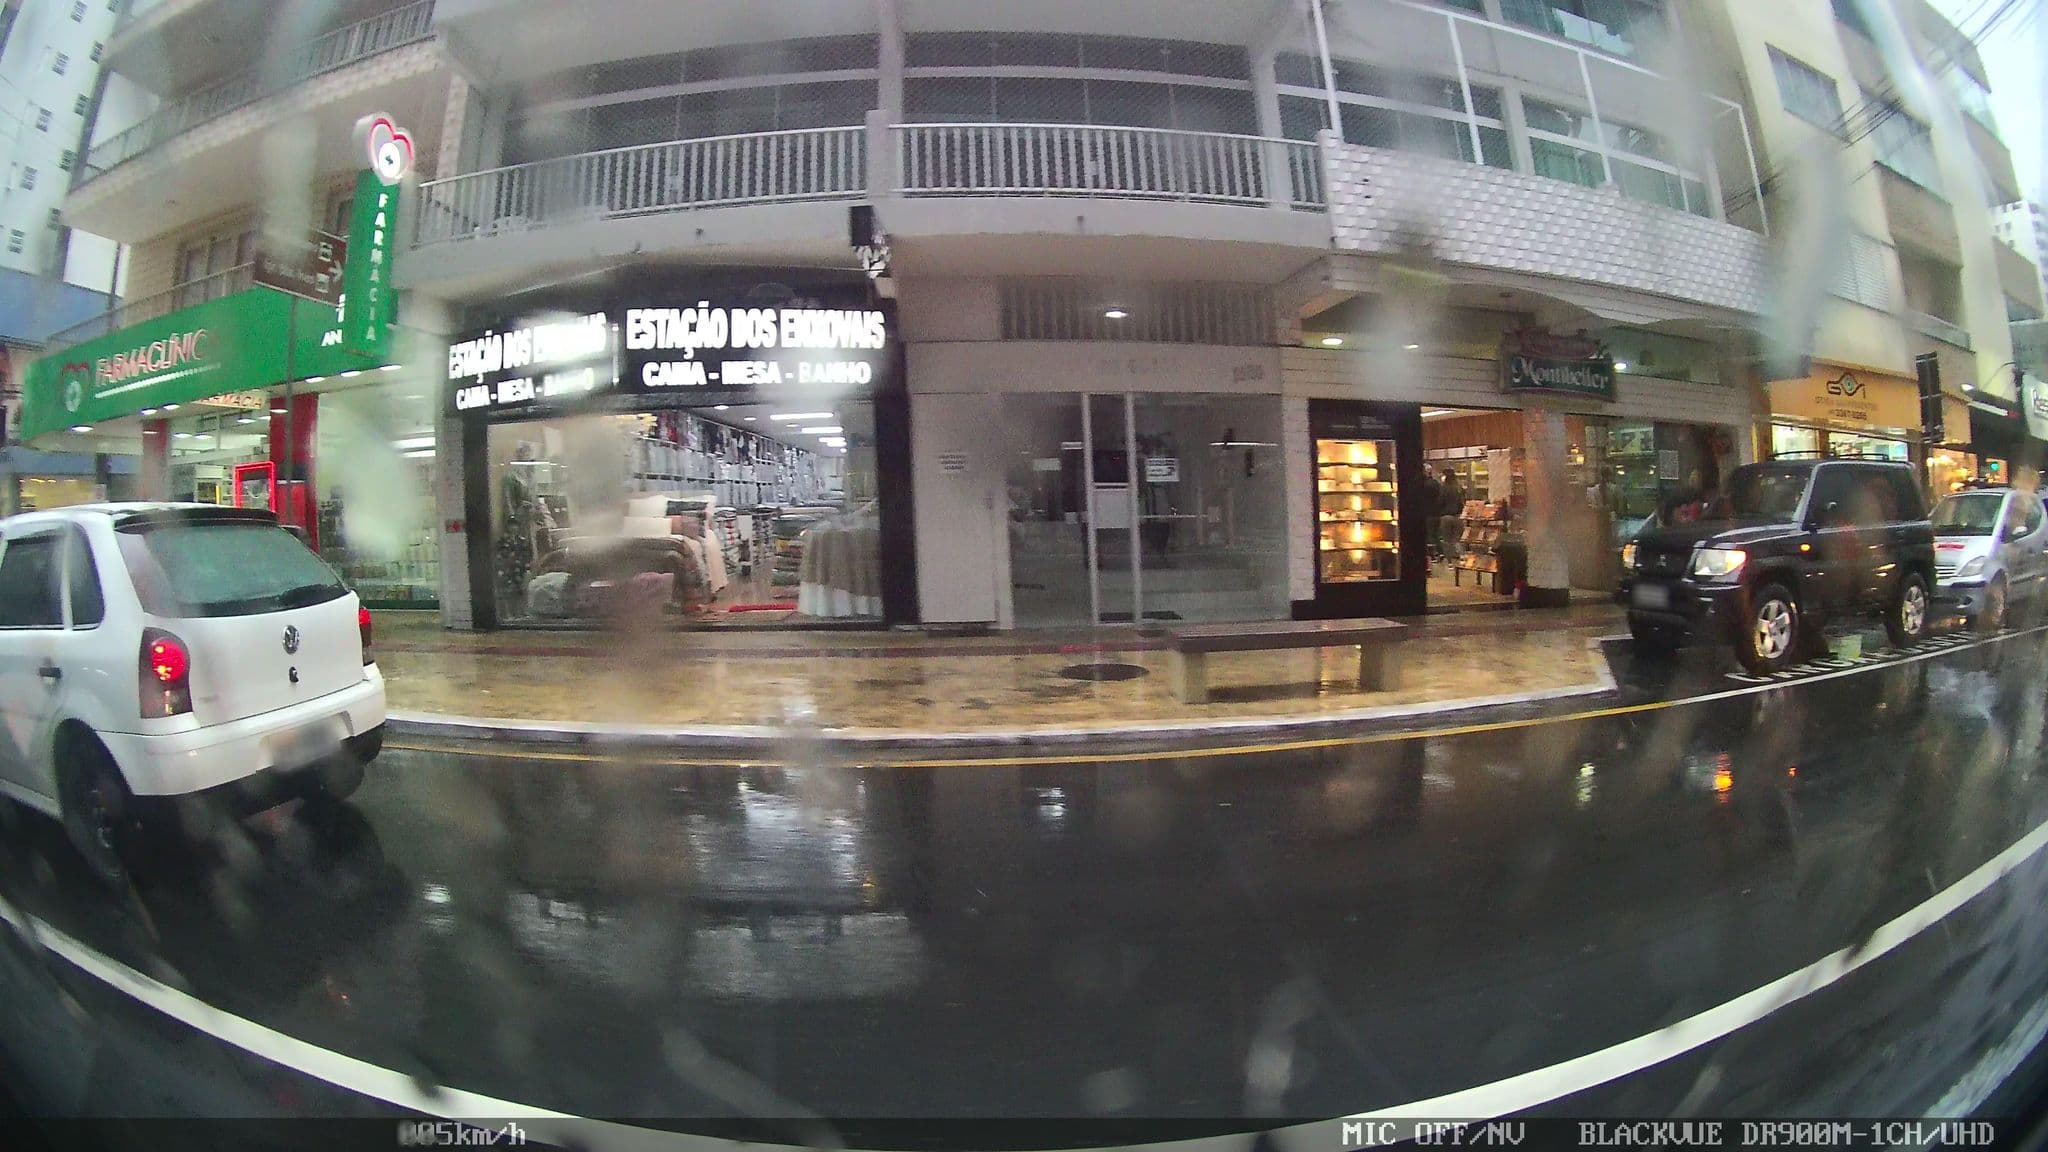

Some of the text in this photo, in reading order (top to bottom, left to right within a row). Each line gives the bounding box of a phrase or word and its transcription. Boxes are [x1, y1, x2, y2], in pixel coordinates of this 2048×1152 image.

[366, 193, 389, 341] FARMACIA
[503, 328, 531, 369] DOS
[627, 301, 728, 359] ESTAÇÃO
[731, 308, 777, 349] DOS
[498, 377, 535, 403] MESA
[642, 361, 707, 386] CAMA
[721, 361, 782, 385] MESA
